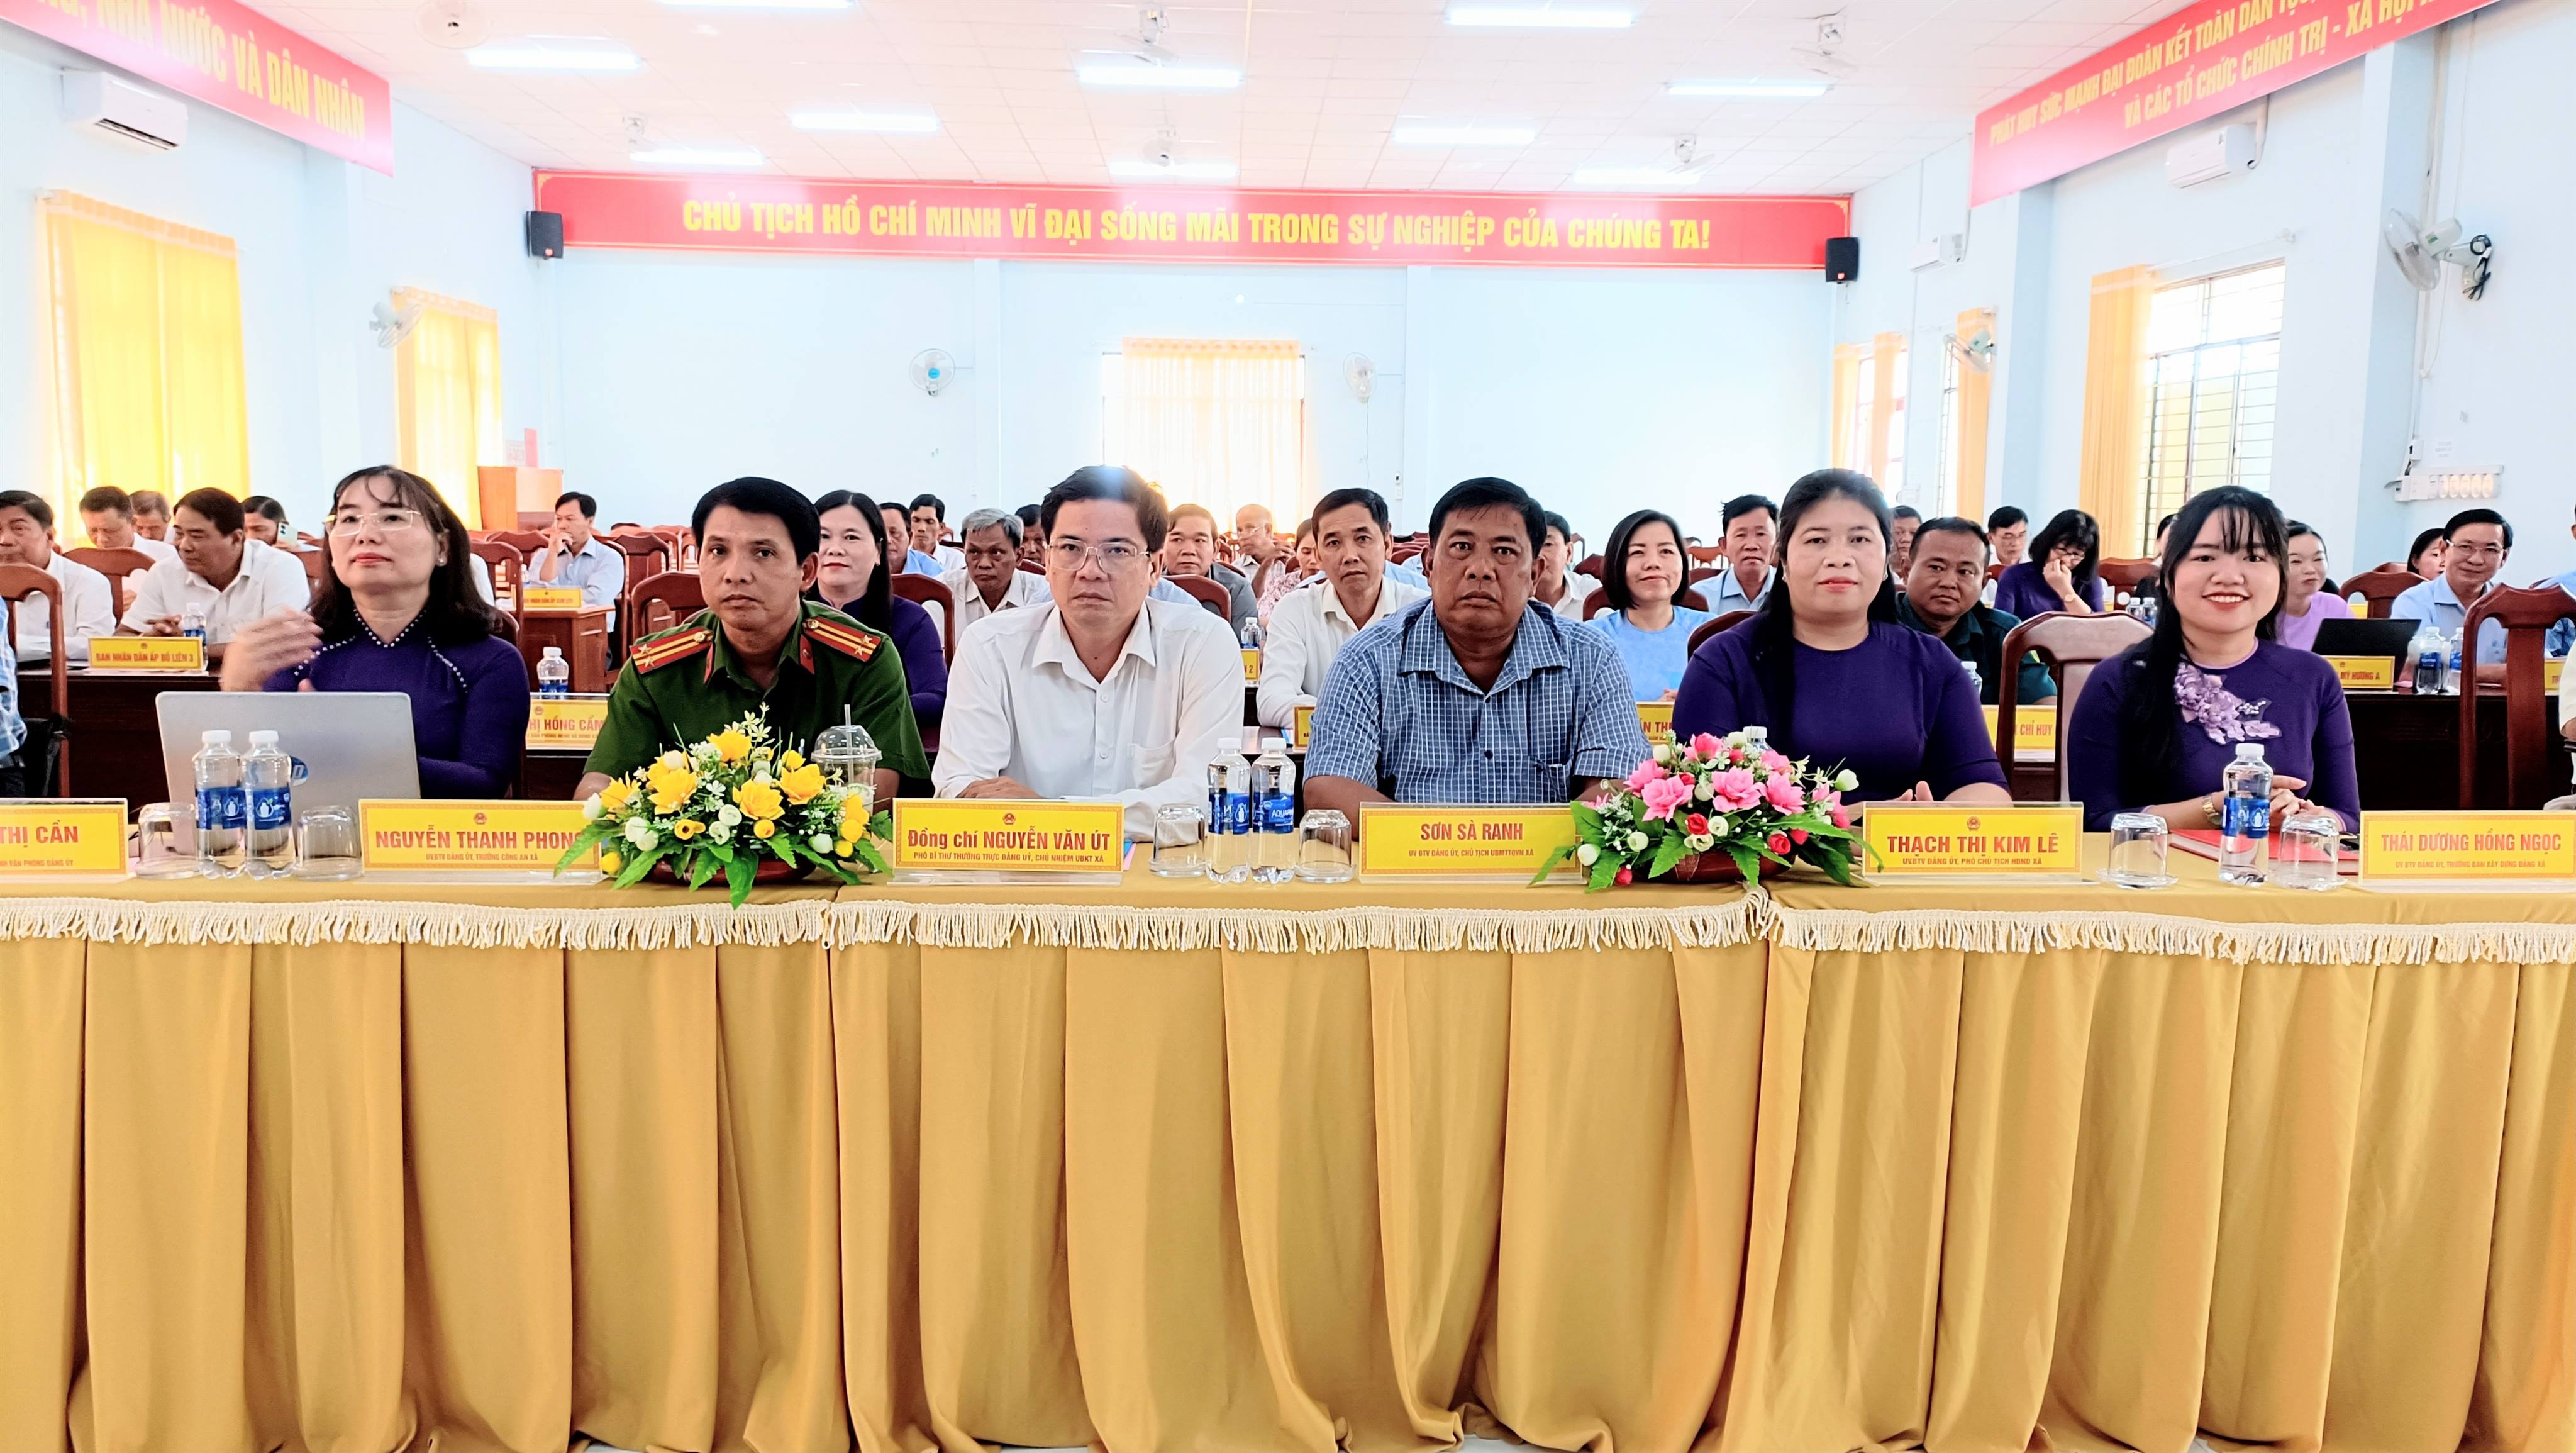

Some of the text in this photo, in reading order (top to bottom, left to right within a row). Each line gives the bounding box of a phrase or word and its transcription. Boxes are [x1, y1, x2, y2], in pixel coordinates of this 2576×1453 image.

[2018, 104, 2038, 135] HUY
[2040, 91, 2063, 124] SỨC
[2063, 74, 2101, 113] MẠNH
[2102, 62, 2123, 97] ĐẠI
[2126, 43, 2163, 84] ĐOÀN
[2165, 23, 2192, 67] KẾT
[2195, 9, 2235, 53] TOÀN
[2125, 94, 2141, 129] VÀ
[2145, 85, 2172, 120] CÁC
[2175, 64, 2194, 108] TỔ
[2196, 56, 2238, 100] CHỨC
[2241, 35, 2294, 81] CHÍNH
[2299, 16, 2328, 57] TRỊ
[231, 30, 264, 99] VÀ
[267, 48, 310, 120] DÂN
[314, 74, 365, 142] NHÂN
[684, 192, 1710, 252] CHỦ TỊCH HỒ CHÍ MINH VĨ ĐẠI SỐNG MÃI TRONG SỰ NGHIỆP CỦA CHÚNG TA!
[530, 719, 541, 733] HỊ
[2020, 720, 2035, 735] CHỈ
[2036, 725, 2053, 735] HUY
[36, 820, 79, 843] CẦN
[376, 825, 450, 848] NGUYỄN
[457, 831, 517, 849] THANH
[908, 825, 1110, 850] Đồng chí NGUYỄN VĂN ÚT
[1421, 820, 1523, 840] SƠN SÀ RANH
[1887, 833, 2058, 857] THẠCH THỊ KIM LÊ
[2382, 831, 2413, 851] THÁI
[2419, 832, 2469, 851] DƯƠNG
[2521, 834, 2561, 854] NGỌC
